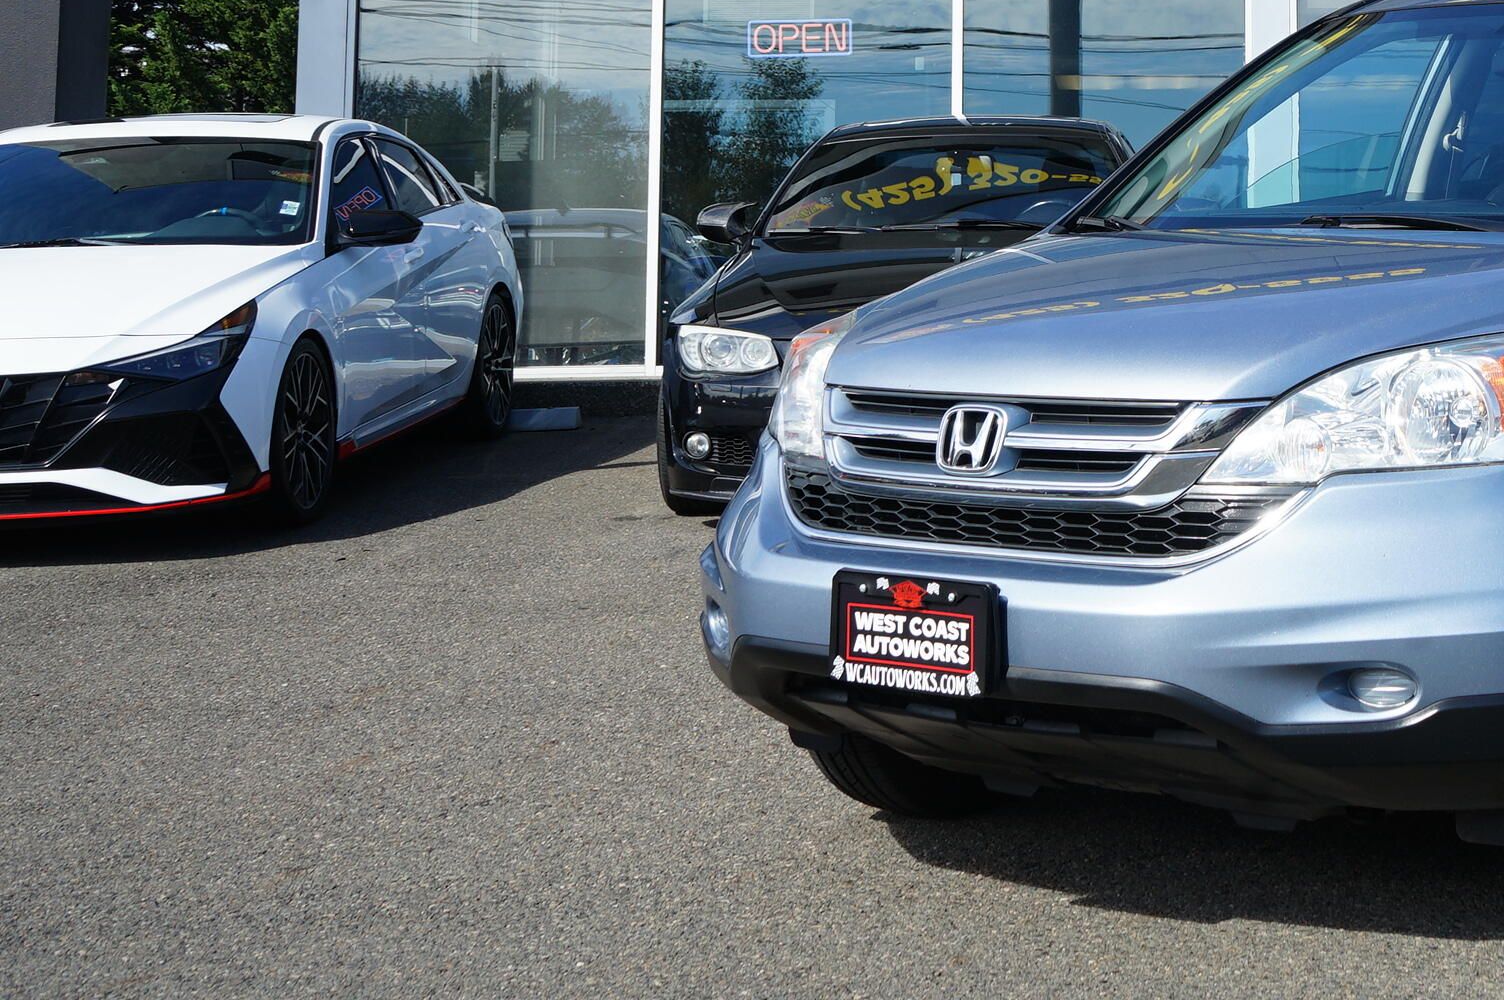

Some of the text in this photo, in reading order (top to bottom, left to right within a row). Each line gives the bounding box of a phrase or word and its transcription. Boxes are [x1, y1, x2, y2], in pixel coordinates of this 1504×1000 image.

[753, 22, 847, 54] OPEN
[854, 611, 970, 642] WEST COAST
[852, 634, 970, 666] AUTOWORKS
[844, 662, 967, 696] WCAUTOWORKS.COM
